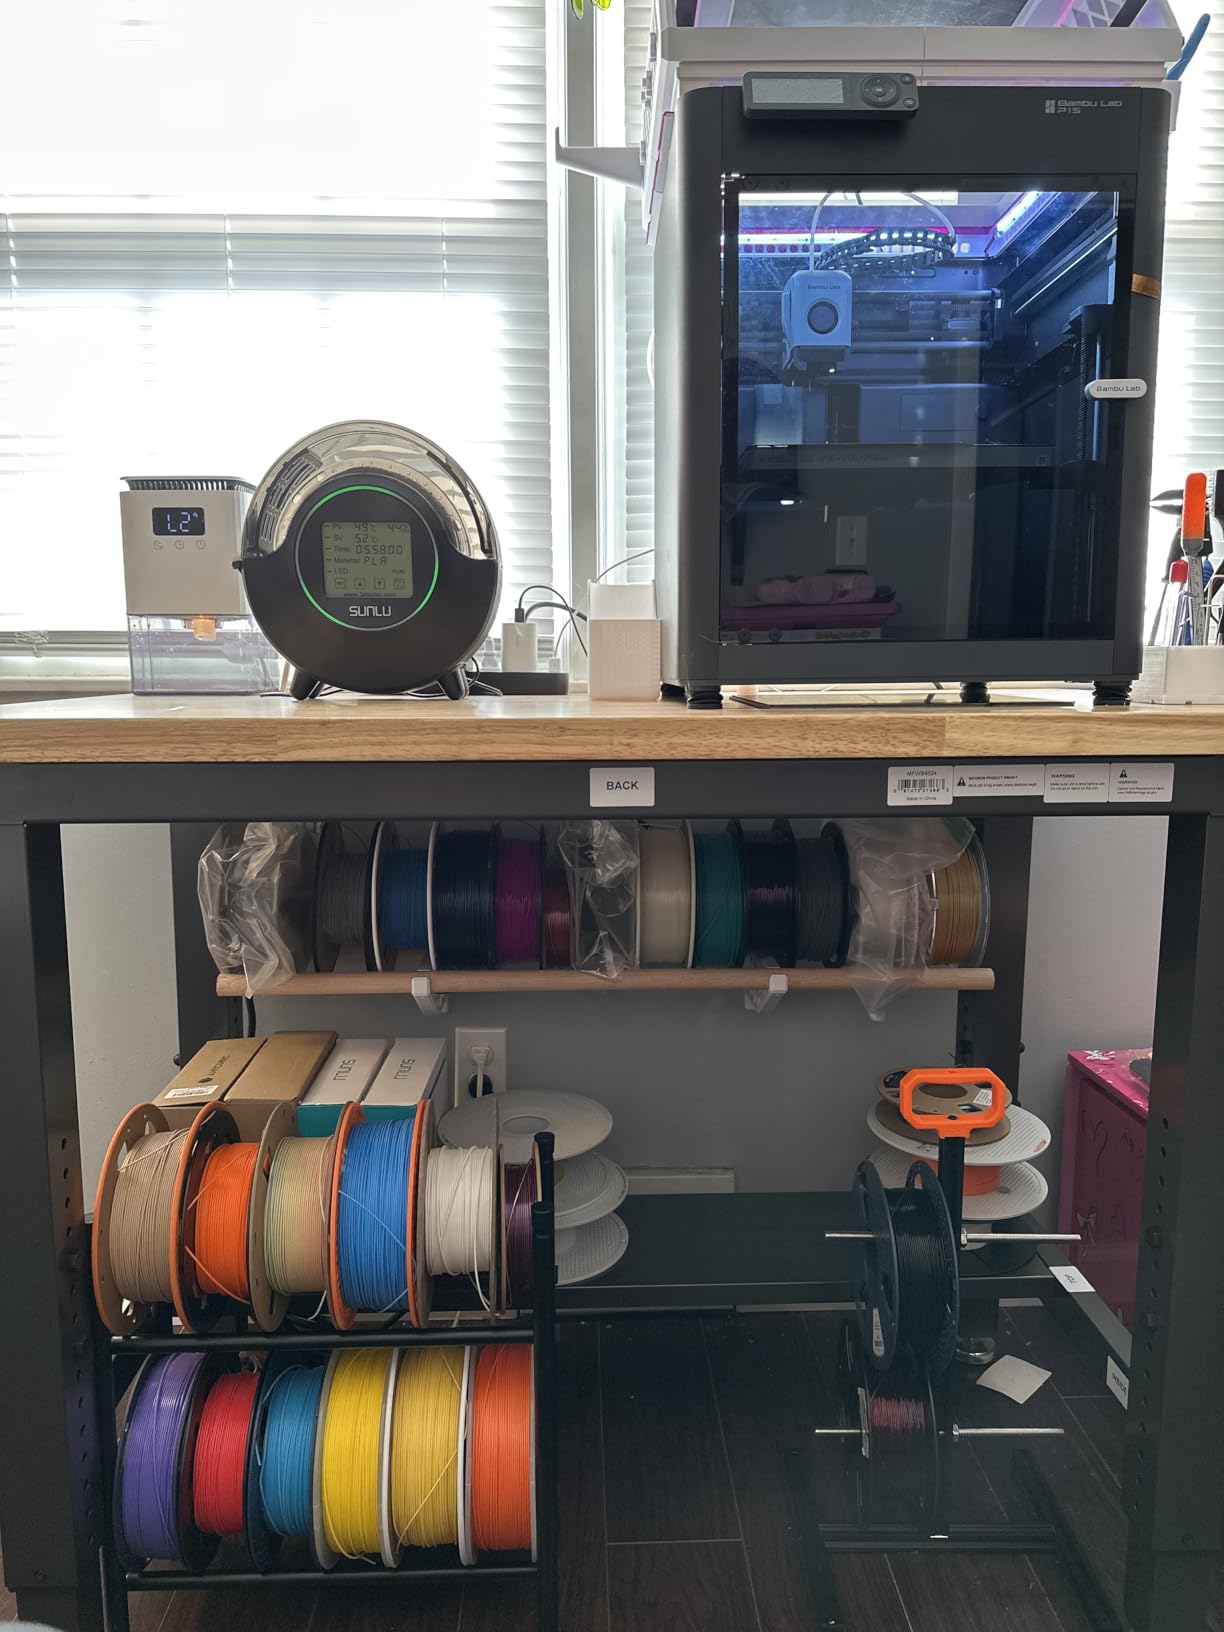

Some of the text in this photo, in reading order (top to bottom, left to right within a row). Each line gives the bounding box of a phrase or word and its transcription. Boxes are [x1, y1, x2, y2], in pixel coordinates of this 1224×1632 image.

[1057, 99, 1122, 107] Bambu Lab
[334, 567, 349, 575] LED
[349, 605, 391, 617] SUNLU
[606, 780, 639, 791] BACK
[333, 1059, 357, 1081] SUNLU
[393, 1058, 416, 1080] SUNLU
